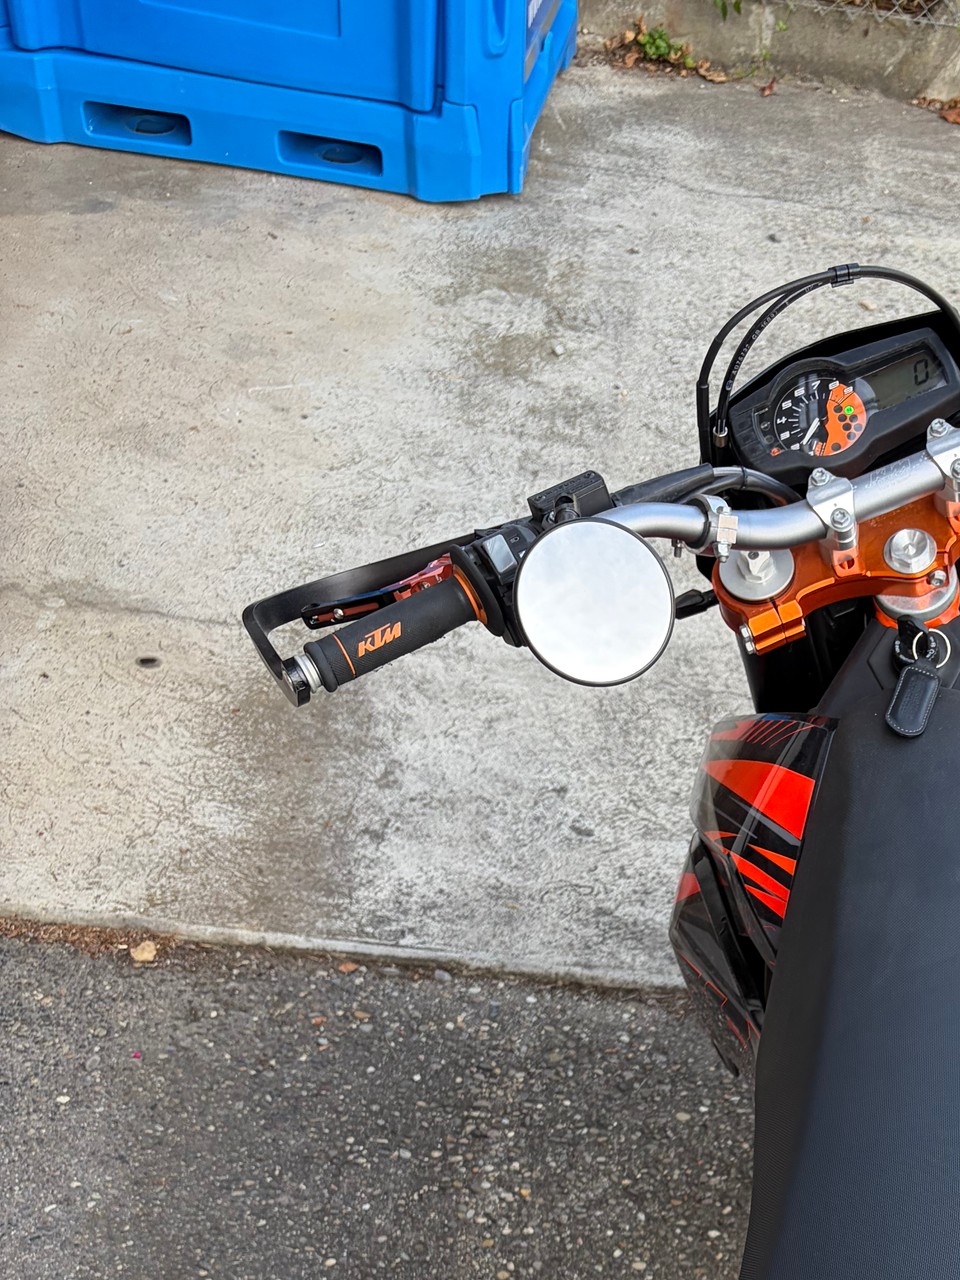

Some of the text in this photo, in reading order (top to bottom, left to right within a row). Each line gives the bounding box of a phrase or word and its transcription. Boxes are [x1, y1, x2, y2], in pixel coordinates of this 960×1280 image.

[811, 380, 821, 390] 7
[776, 416, 787, 424] 4
[358, 621, 401, 658] KTM
